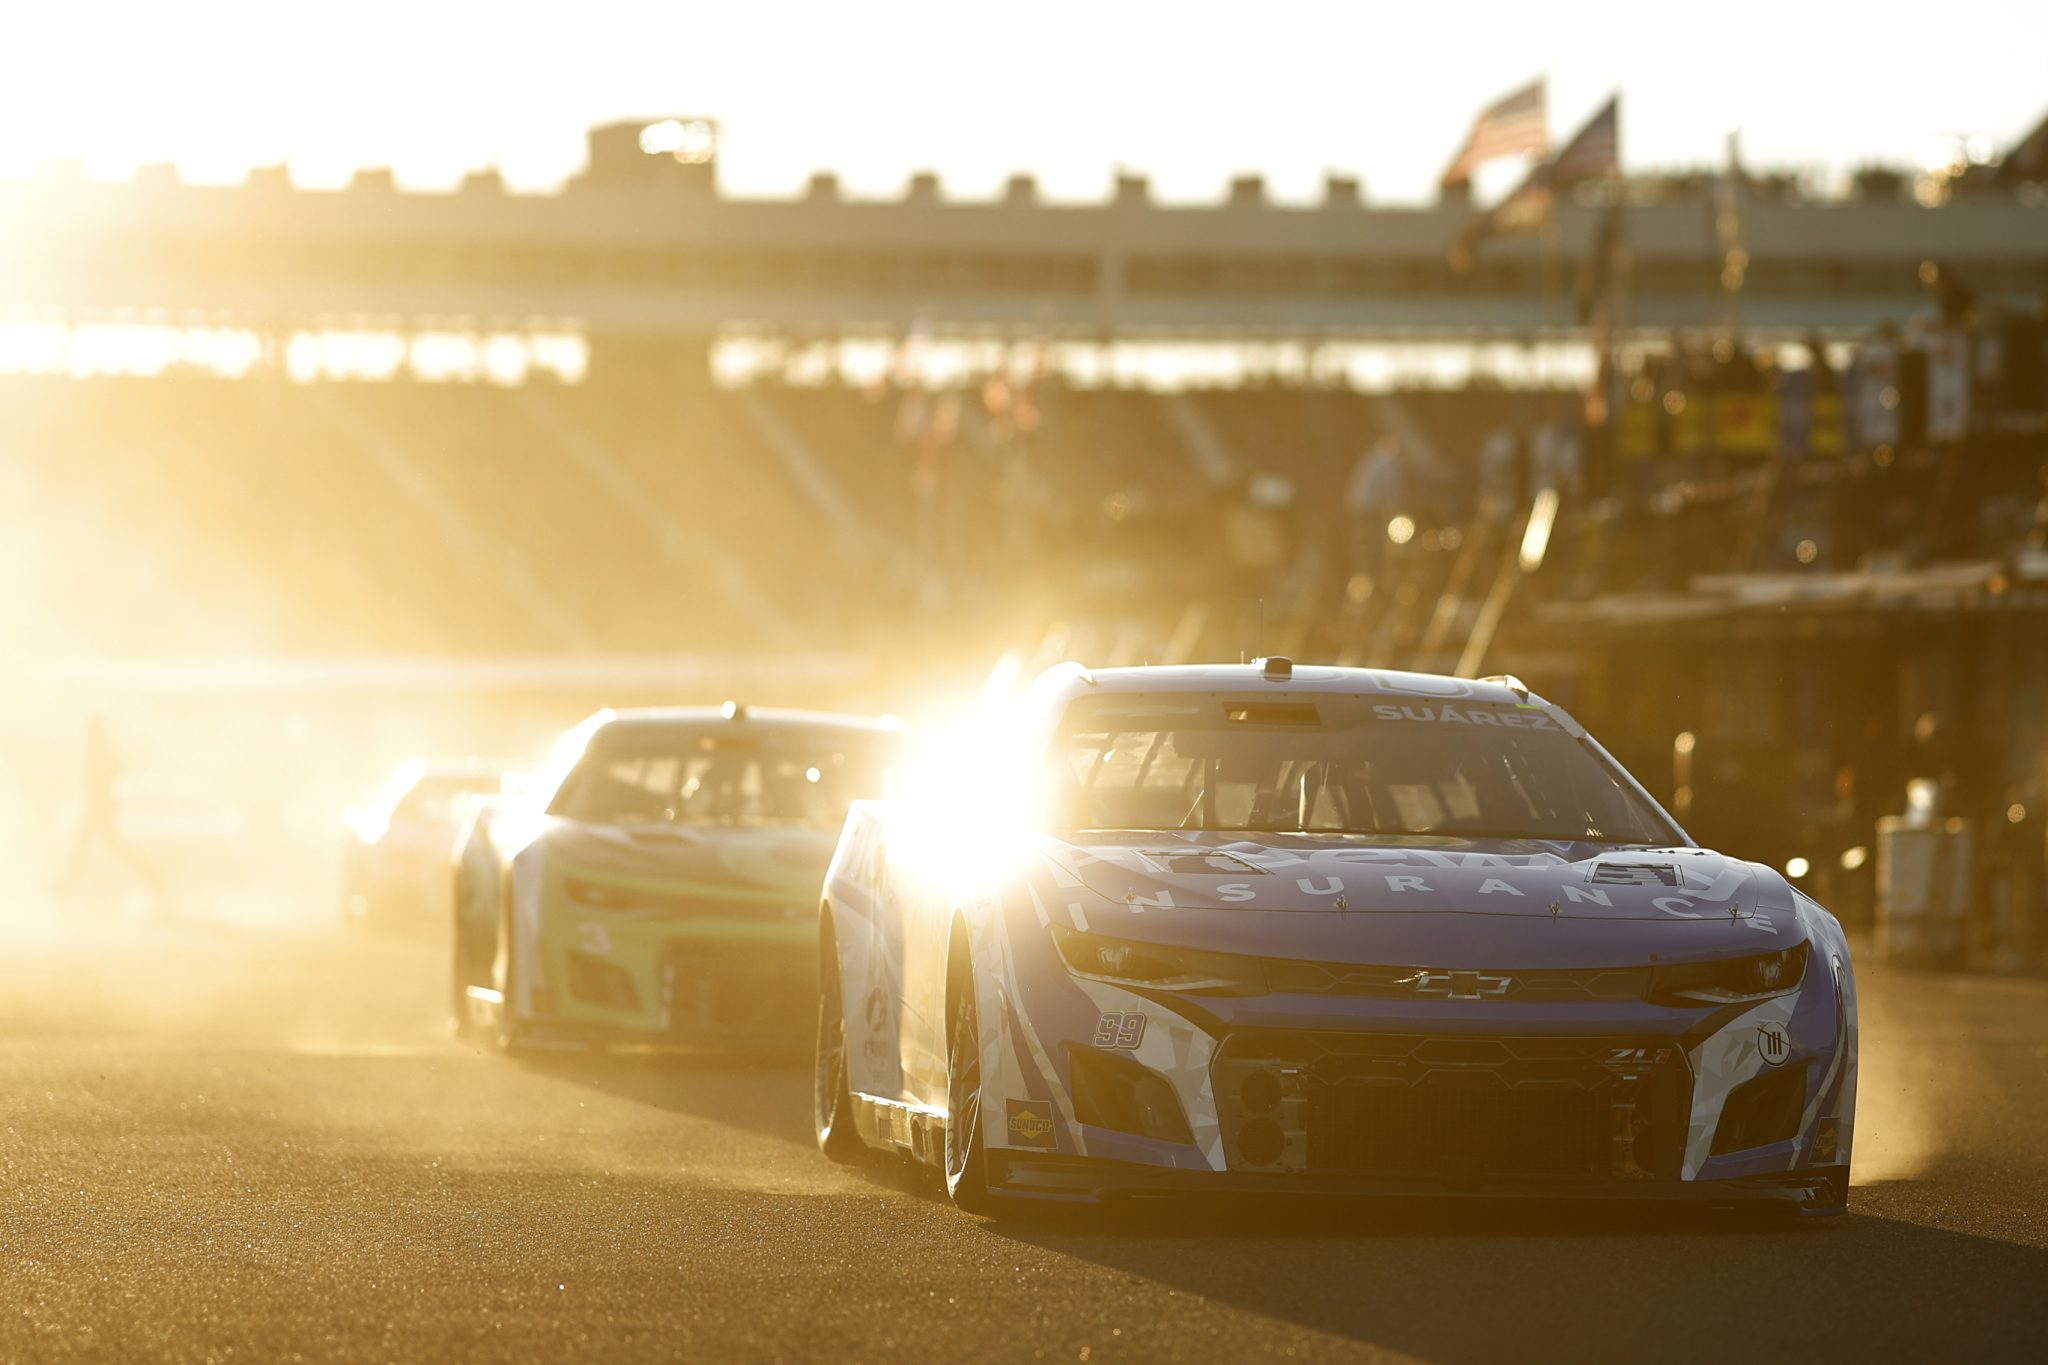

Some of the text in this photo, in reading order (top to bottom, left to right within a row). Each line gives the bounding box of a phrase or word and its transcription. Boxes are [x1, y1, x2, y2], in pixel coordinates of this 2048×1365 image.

[1371, 704, 1561, 731] SUÁREZ
[1066, 875, 1778, 936] INSURANCE
[1095, 1012, 1146, 1049] 99
[1010, 1117, 1050, 1132] SUNOCO
